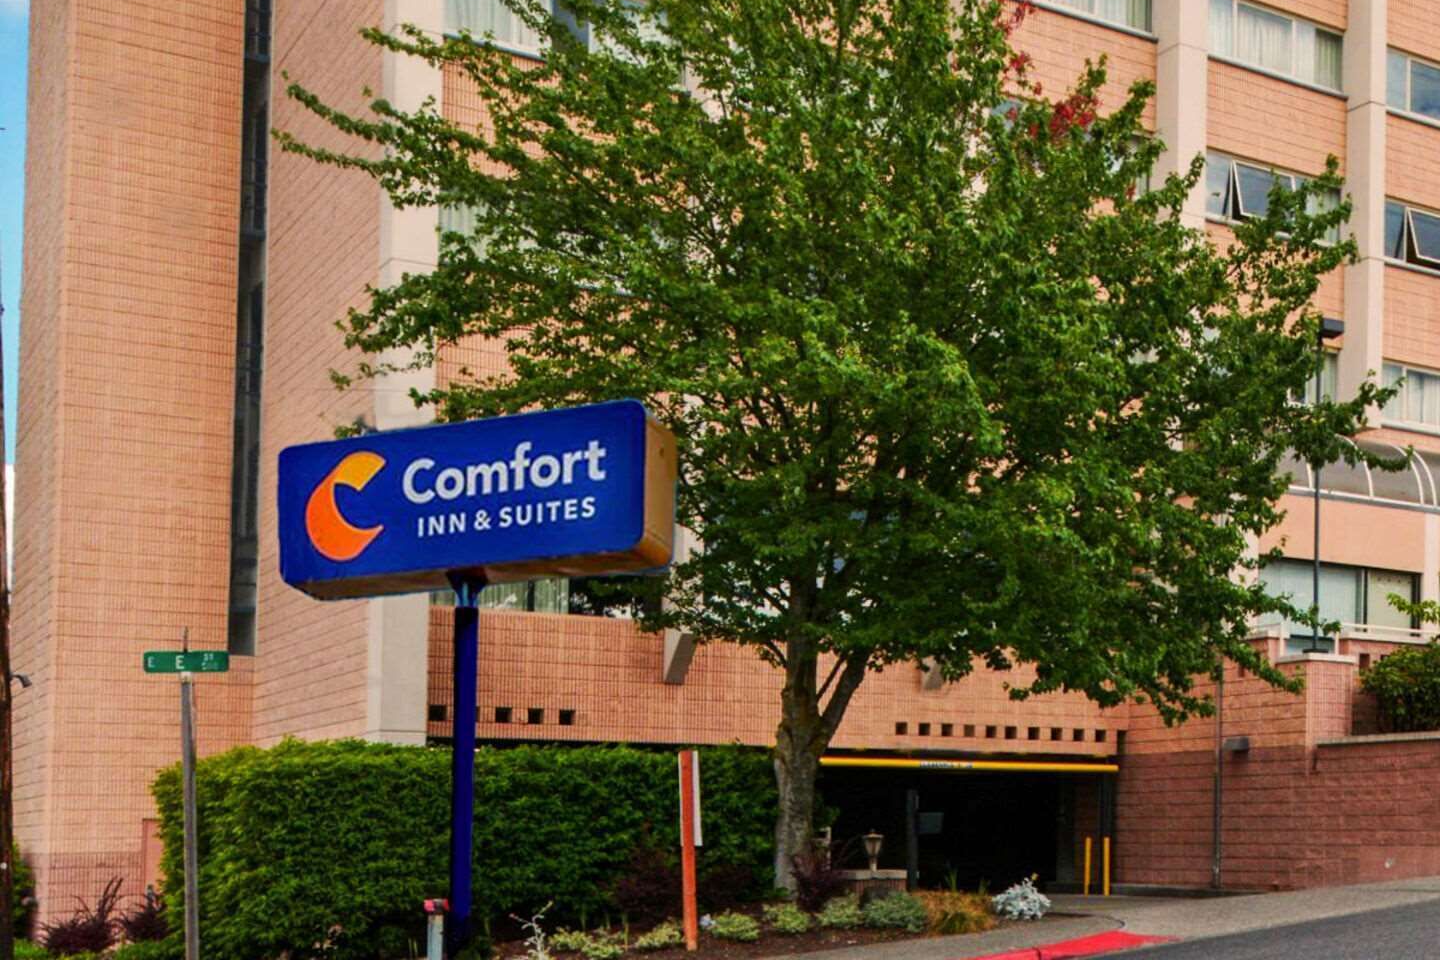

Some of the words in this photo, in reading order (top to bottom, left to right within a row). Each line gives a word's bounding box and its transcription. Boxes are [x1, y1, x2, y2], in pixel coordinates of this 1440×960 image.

[402, 439, 607, 504] Comfort
[417, 512, 466, 538] INN
[473, 509, 491, 531] &
[499, 496, 596, 528] SUITES
[175, 655, 185, 670] E
